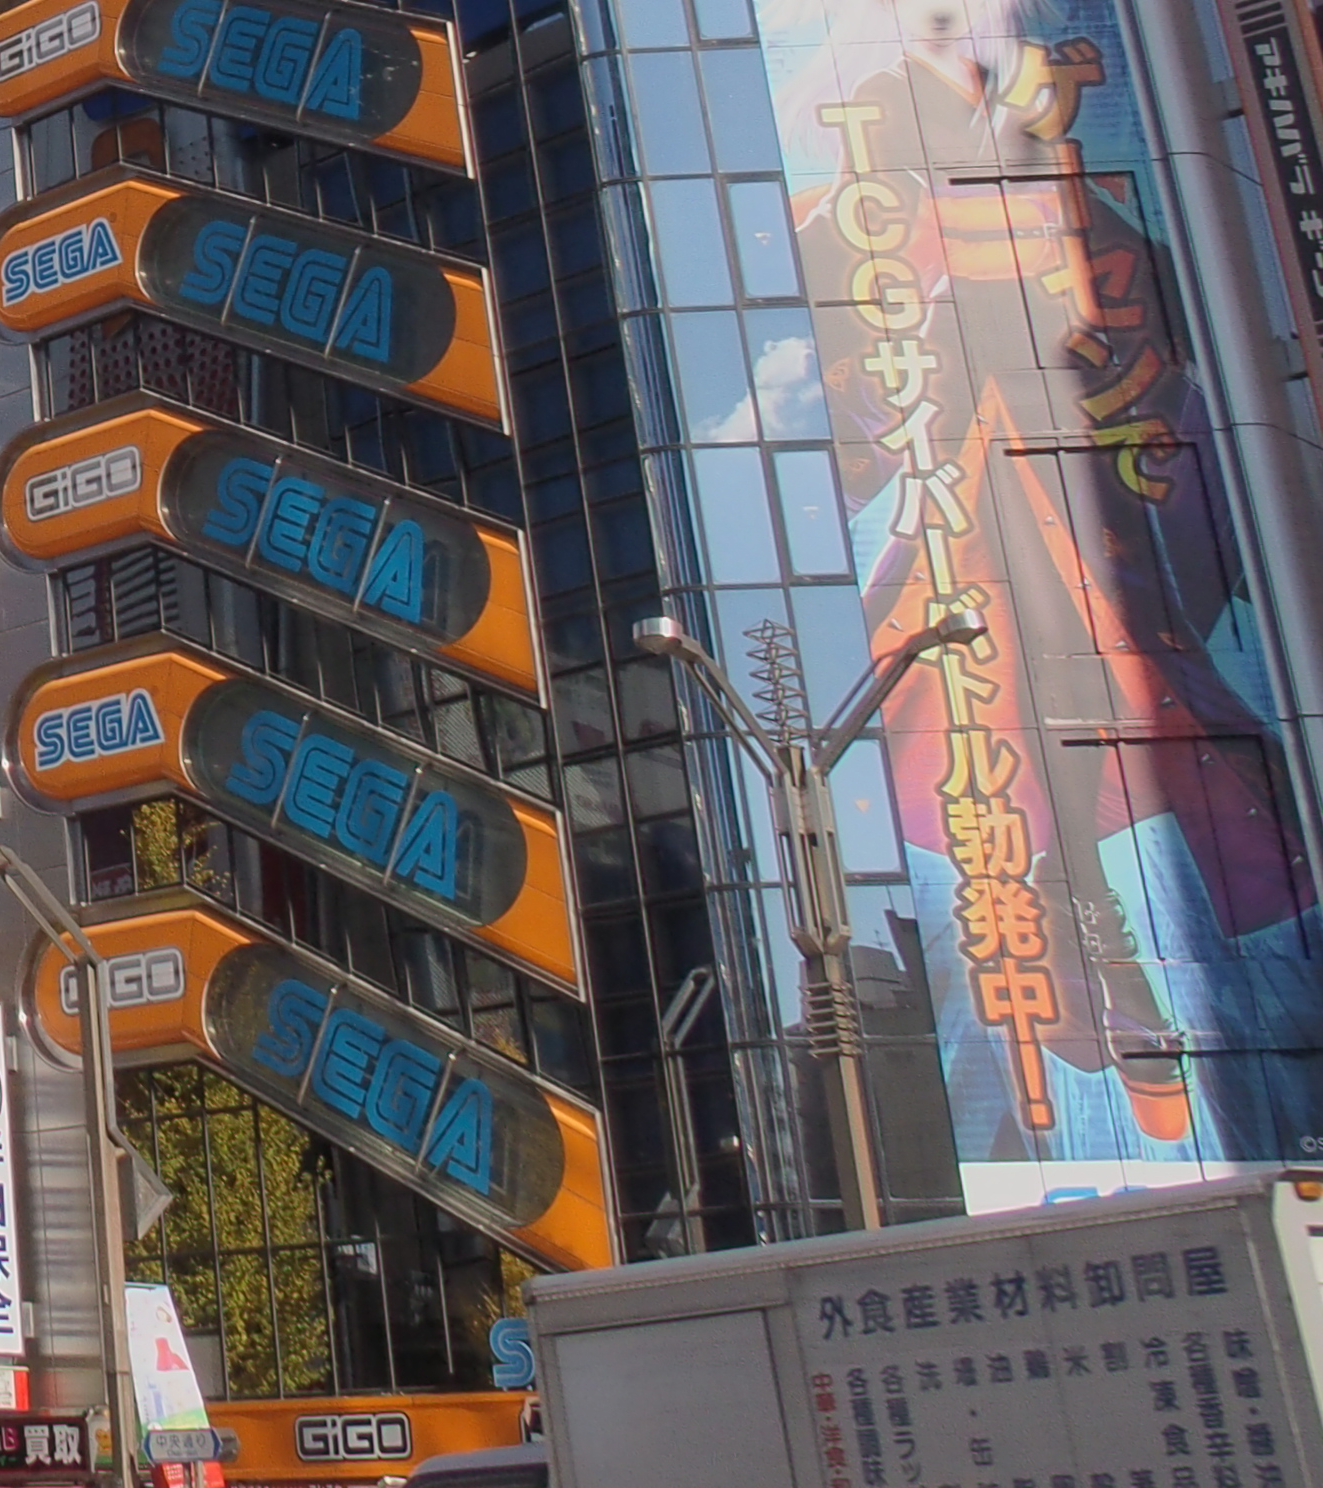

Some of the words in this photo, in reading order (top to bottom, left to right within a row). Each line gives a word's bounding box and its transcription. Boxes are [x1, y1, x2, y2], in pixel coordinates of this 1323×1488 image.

[1254, 37, 1315, 196] アキハバラ
[0, 216, 123, 308] SEGA
[180, 221, 395, 365] SEGA
[202, 457, 425, 624] SEGA
[34, 687, 165, 772] SEGA
[226, 711, 456, 901] SEGA
[252, 978, 492, 1195] SEGA
[23, 1423, 83, 1465] 買取
[156, 1435, 207, 1449] 中央通り
[295, 1413, 412, 1461] GiGO
